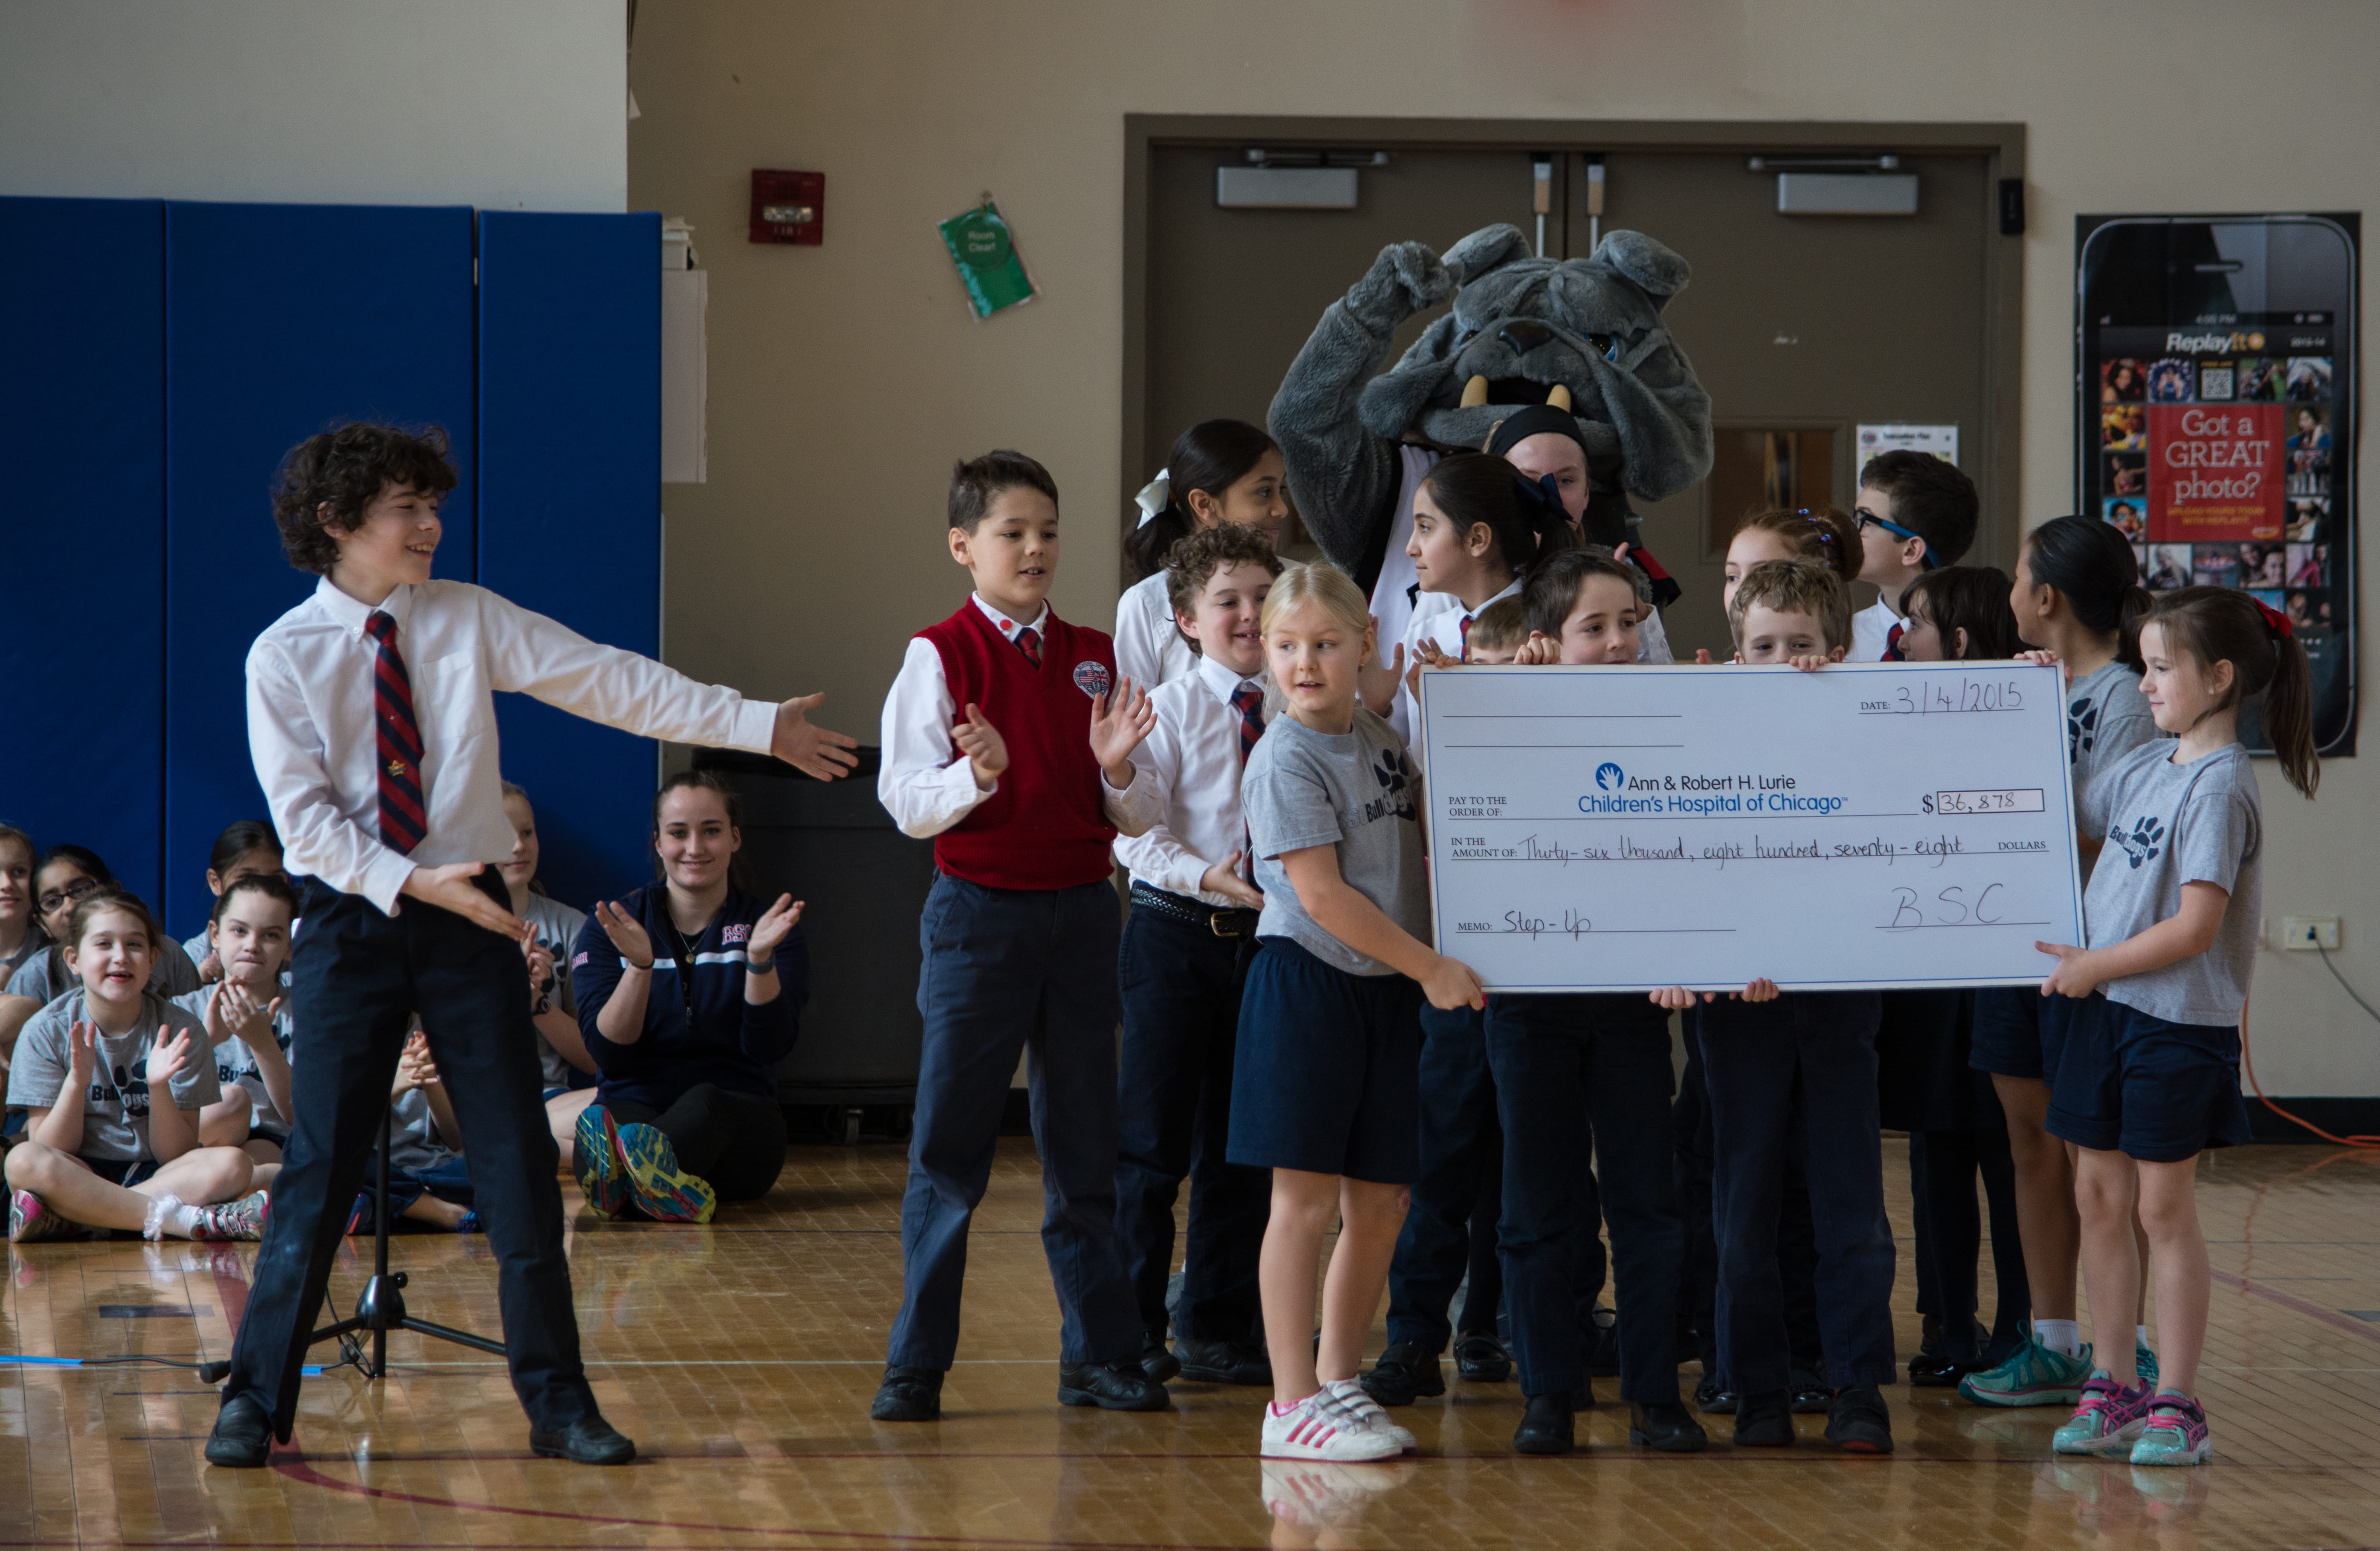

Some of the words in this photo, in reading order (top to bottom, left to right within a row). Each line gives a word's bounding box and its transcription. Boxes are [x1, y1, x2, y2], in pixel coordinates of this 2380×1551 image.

[2181, 409, 2230, 436] Got
[2237, 417, 2254, 436] a
[2166, 441, 2270, 468] GREAT
[2175, 470, 2261, 505] photo?
[1860, 702, 1890, 710] DATE:
[1897, 678, 2021, 716] 3/4/2015
[1628, 776, 1659, 790] Ann
[1664, 776, 1676, 790] &
[1681, 775, 1733, 790] Robert
[1739, 775, 1754, 790] H.
[1759, 775, 1796, 790] Lurie
[1578, 795, 1663, 813] Children's
[1668, 793, 1741, 815] Hospital
[1746, 793, 1764, 811] of
[1704, 839, 1745, 870] eight
[1998, 841, 2046, 850] DOLLARS
